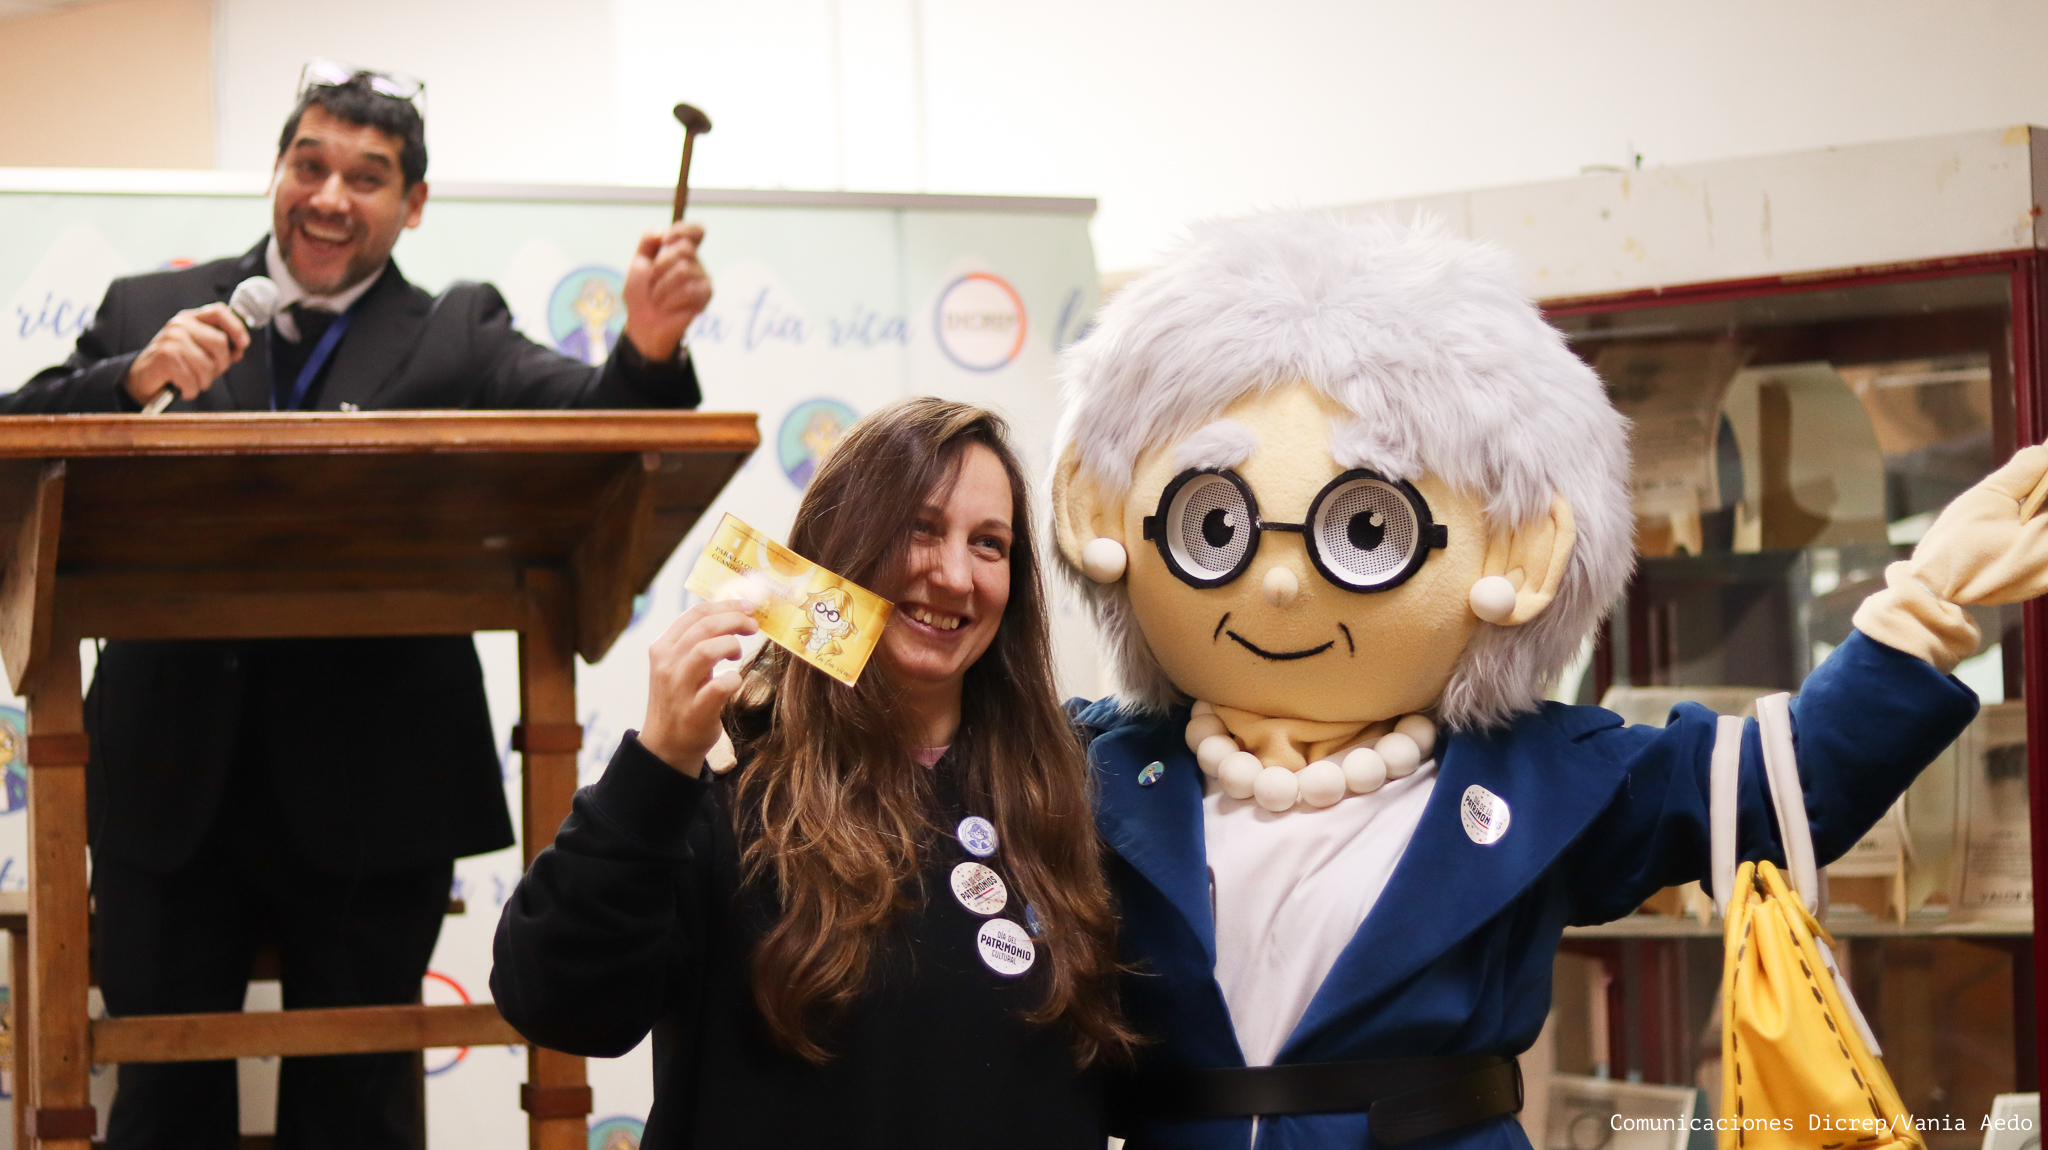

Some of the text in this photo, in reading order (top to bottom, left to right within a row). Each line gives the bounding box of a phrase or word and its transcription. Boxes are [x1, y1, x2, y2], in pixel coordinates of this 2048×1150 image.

[711, 552, 741, 573] CUANDO
[714, 546, 733, 560] PARA
[732, 556, 744, 566] LO
[960, 875, 998, 901] PATRIMONIOS
[980, 933, 1032, 961] PATRIMONIO
[997, 931, 1017, 945] DÍA DEL
[991, 949, 1016, 965] CULTURAL
